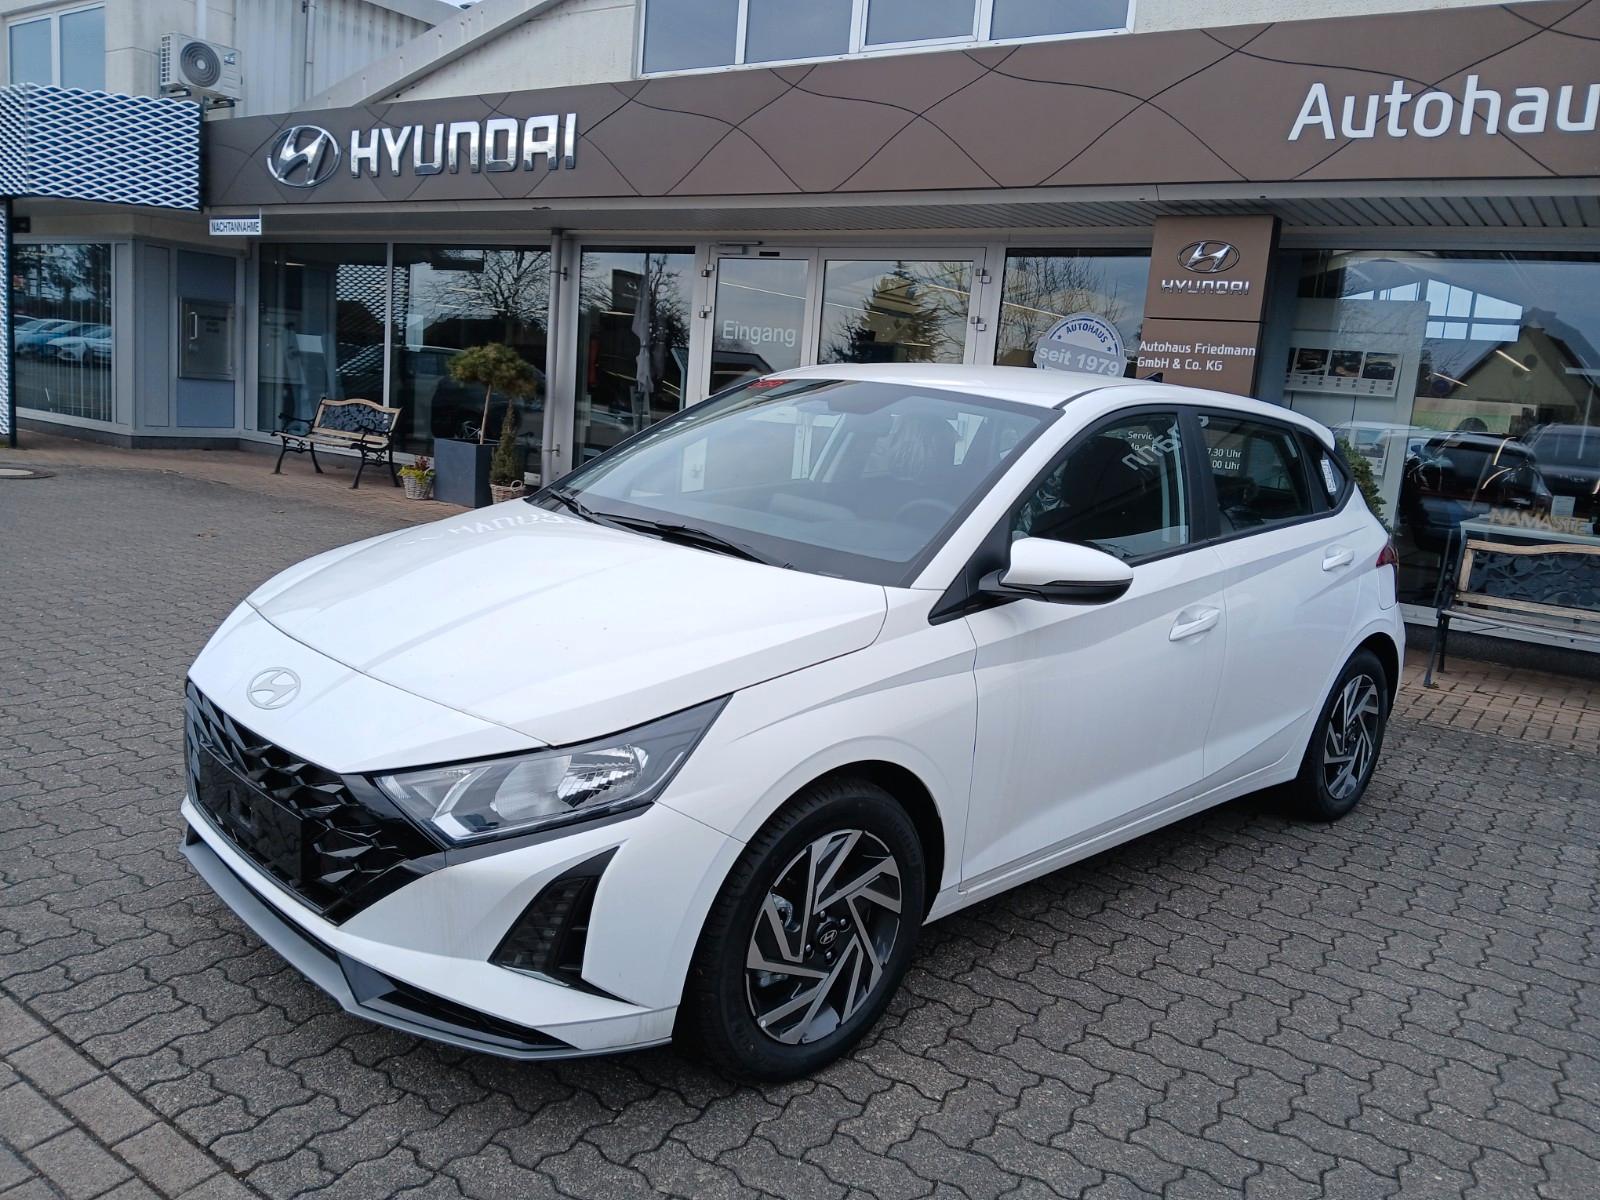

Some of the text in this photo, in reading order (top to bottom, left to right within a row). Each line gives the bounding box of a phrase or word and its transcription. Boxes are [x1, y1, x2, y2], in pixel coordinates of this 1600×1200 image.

[350, 112, 577, 178] HYUNDAI
[210, 221, 260, 233] NACHTANNAHME
[1161, 279, 1250, 295] HYUNDAI
[722, 320, 797, 348] Eingang
[1065, 322, 1109, 344] AUTOHAUS
[1138, 340, 1256, 356] Autohaus Friedmann
[1038, 347, 1120, 377] seit 1979
[1137, 356, 1223, 372] GmbH & Co. KG
[1127, 430, 1154, 440] Servic
[1226, 449, 1242, 458] Uhr
[1212, 460, 1241, 470] 00 Uhr
